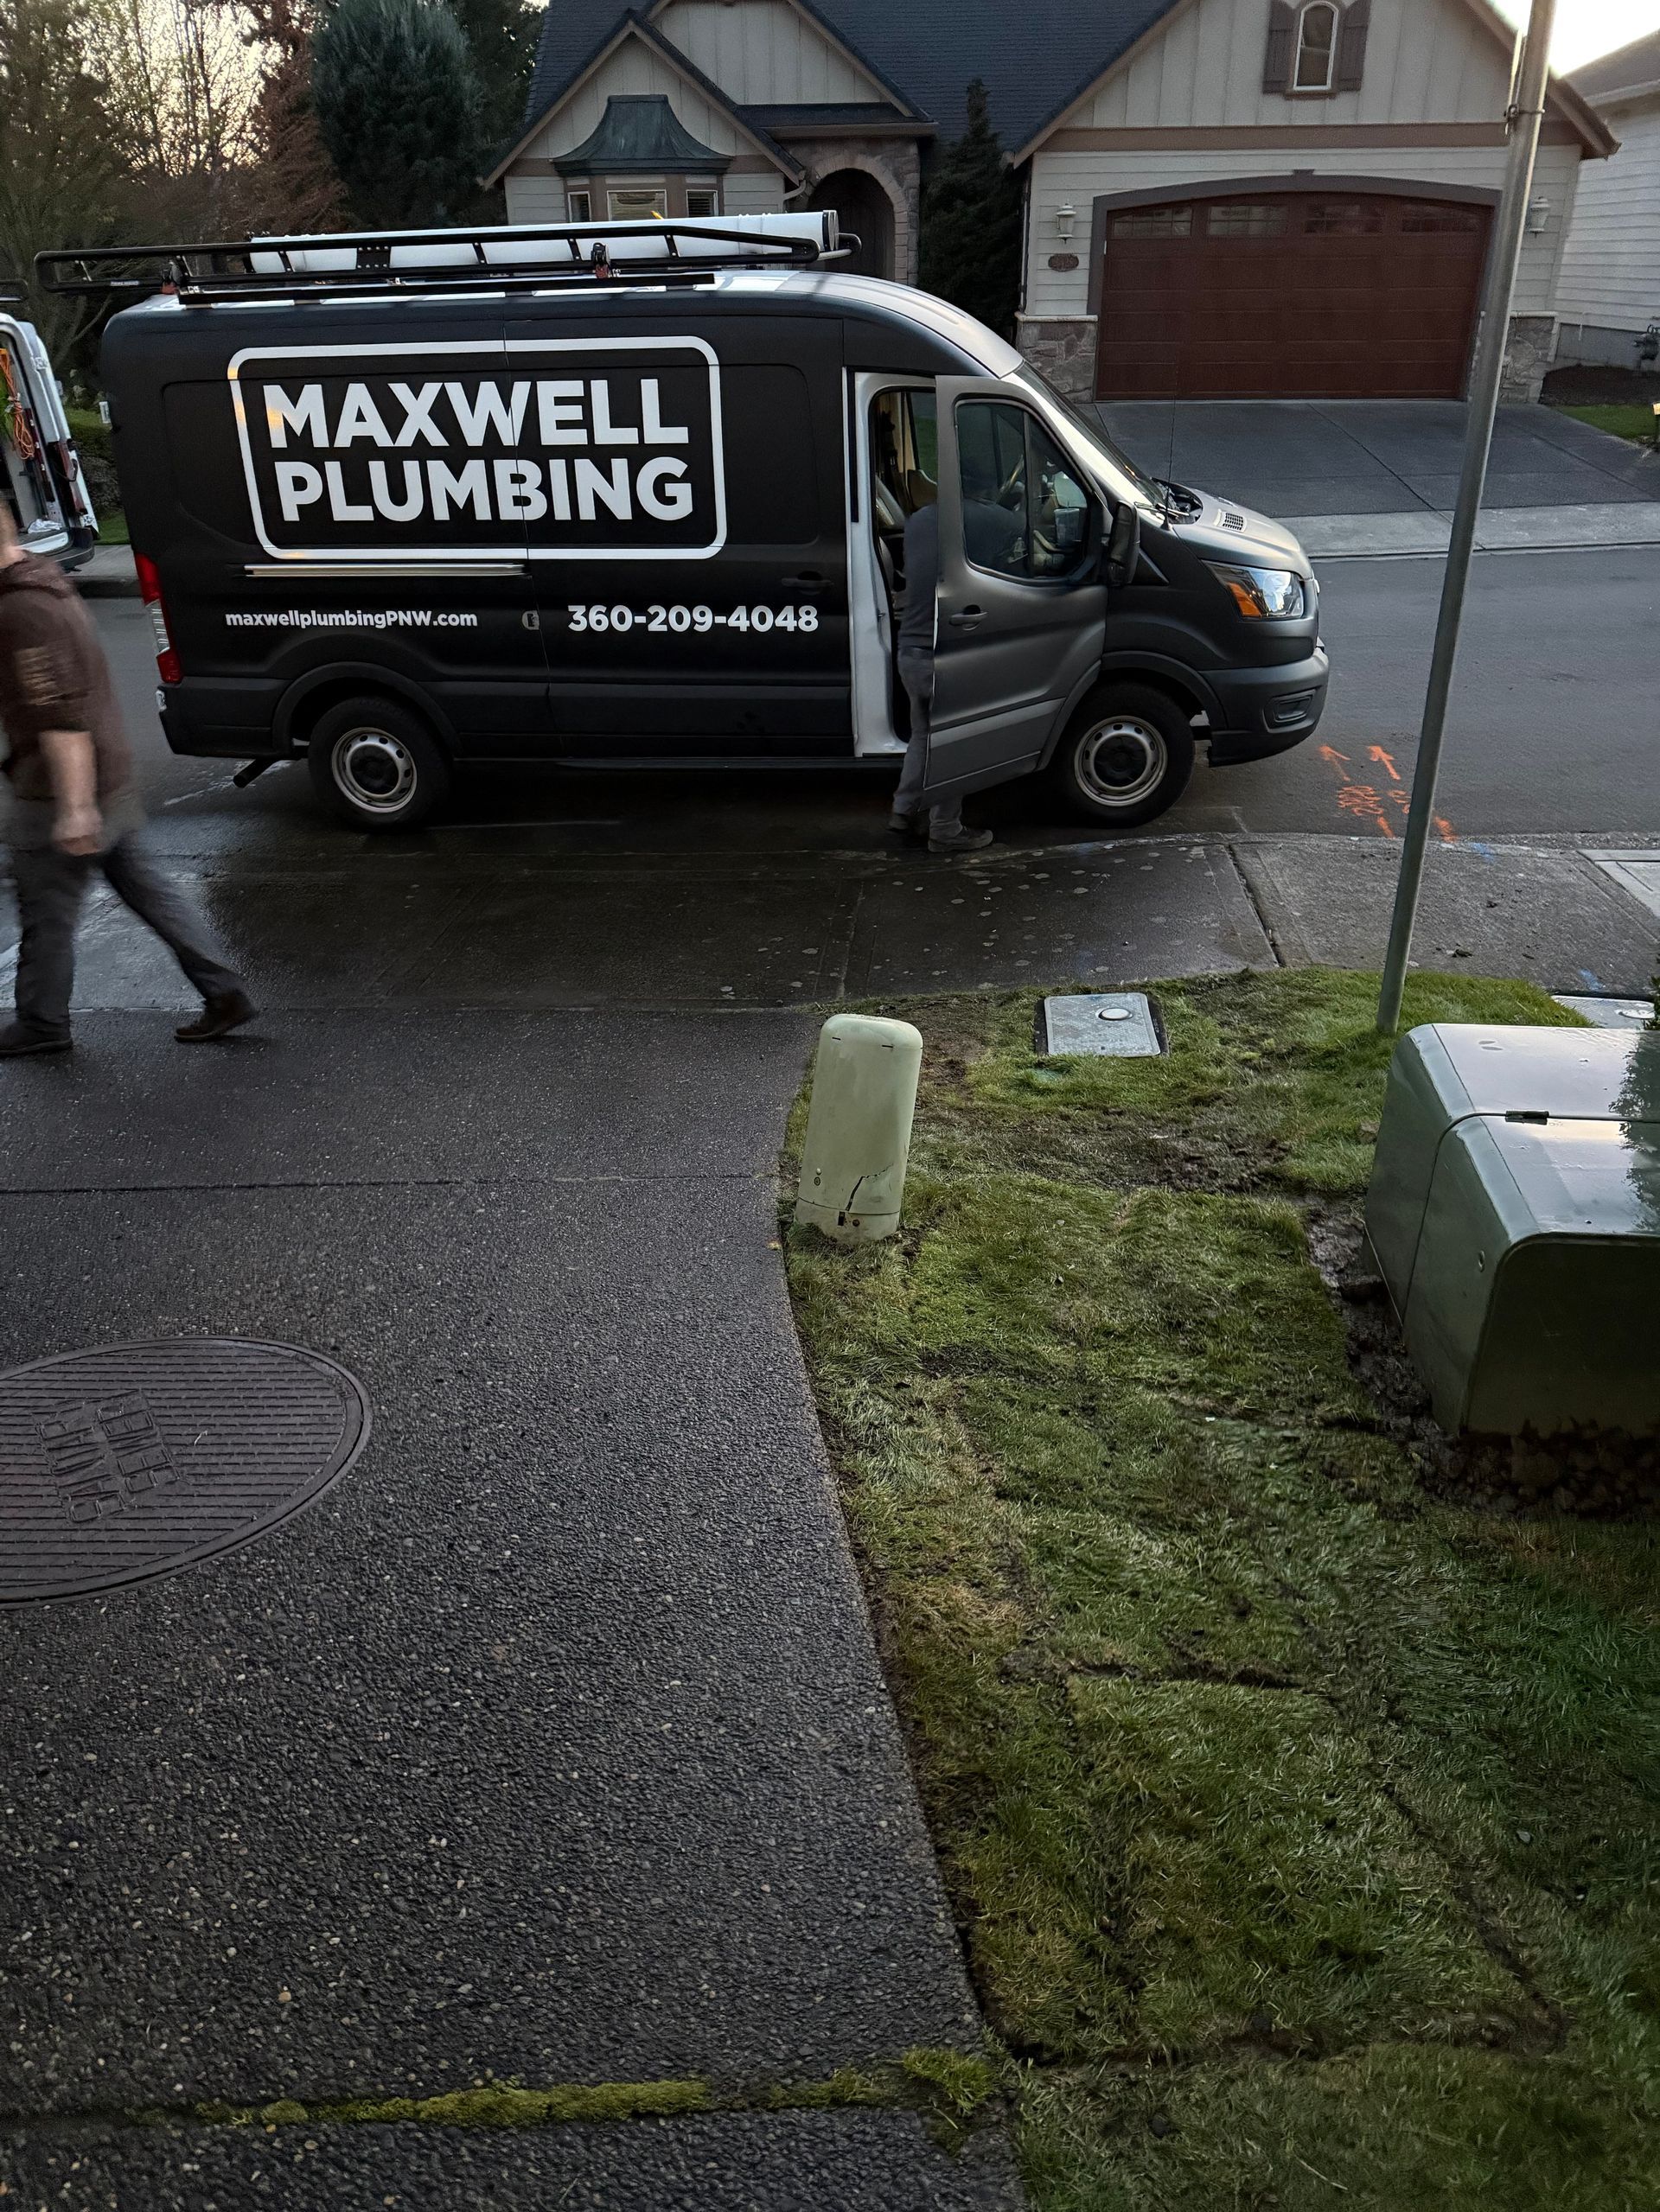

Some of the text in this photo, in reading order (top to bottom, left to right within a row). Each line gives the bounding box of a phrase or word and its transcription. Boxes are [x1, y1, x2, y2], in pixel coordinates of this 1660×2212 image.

[262, 378, 689, 448] MAXWELL
[274, 456, 693, 522] PLUMBING
[225, 609, 478, 628] maxwellplumbingPNW.com
[567, 604, 819, 633] 360-209-4048
